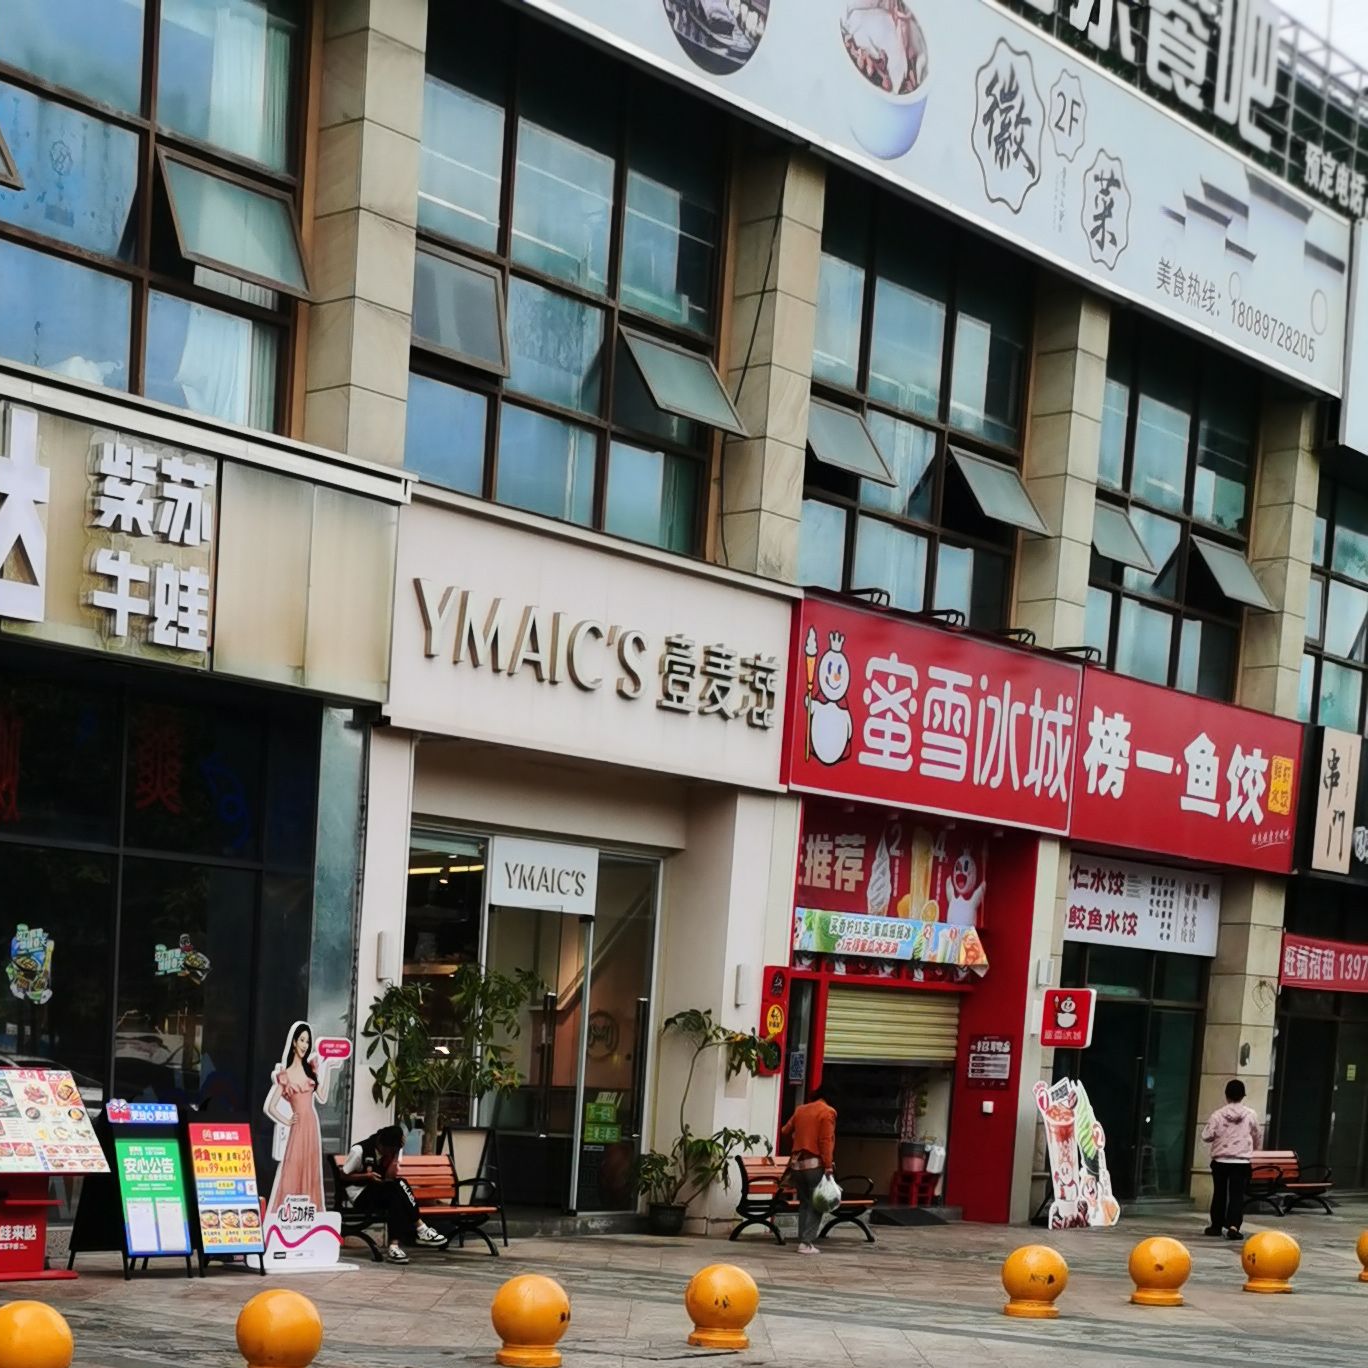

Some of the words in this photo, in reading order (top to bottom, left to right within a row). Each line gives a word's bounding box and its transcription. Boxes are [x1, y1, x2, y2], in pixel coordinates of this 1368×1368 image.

[983, 63, 1036, 178] 徽
[1055, 91, 1081, 137] 2F
[1090, 168, 1121, 251] 菜
[1304, 140, 1366, 217] 预定电话
[1230, 299, 1316, 363] 18089728205
[91, 438, 217, 546] 紫苏
[88, 546, 212, 652] 牛蛙
[412, 577, 649, 700] YMAIC'S
[857, 652, 1074, 803] 蜜雪冰城
[504, 861, 587, 898] YMAIC'S
[799, 832, 867, 893] 推荐
[1069, 864, 1126, 897] 仁水饺
[1339, 952, 1368, 981] 1397
[123, 1157, 175, 1174] 安心公告
